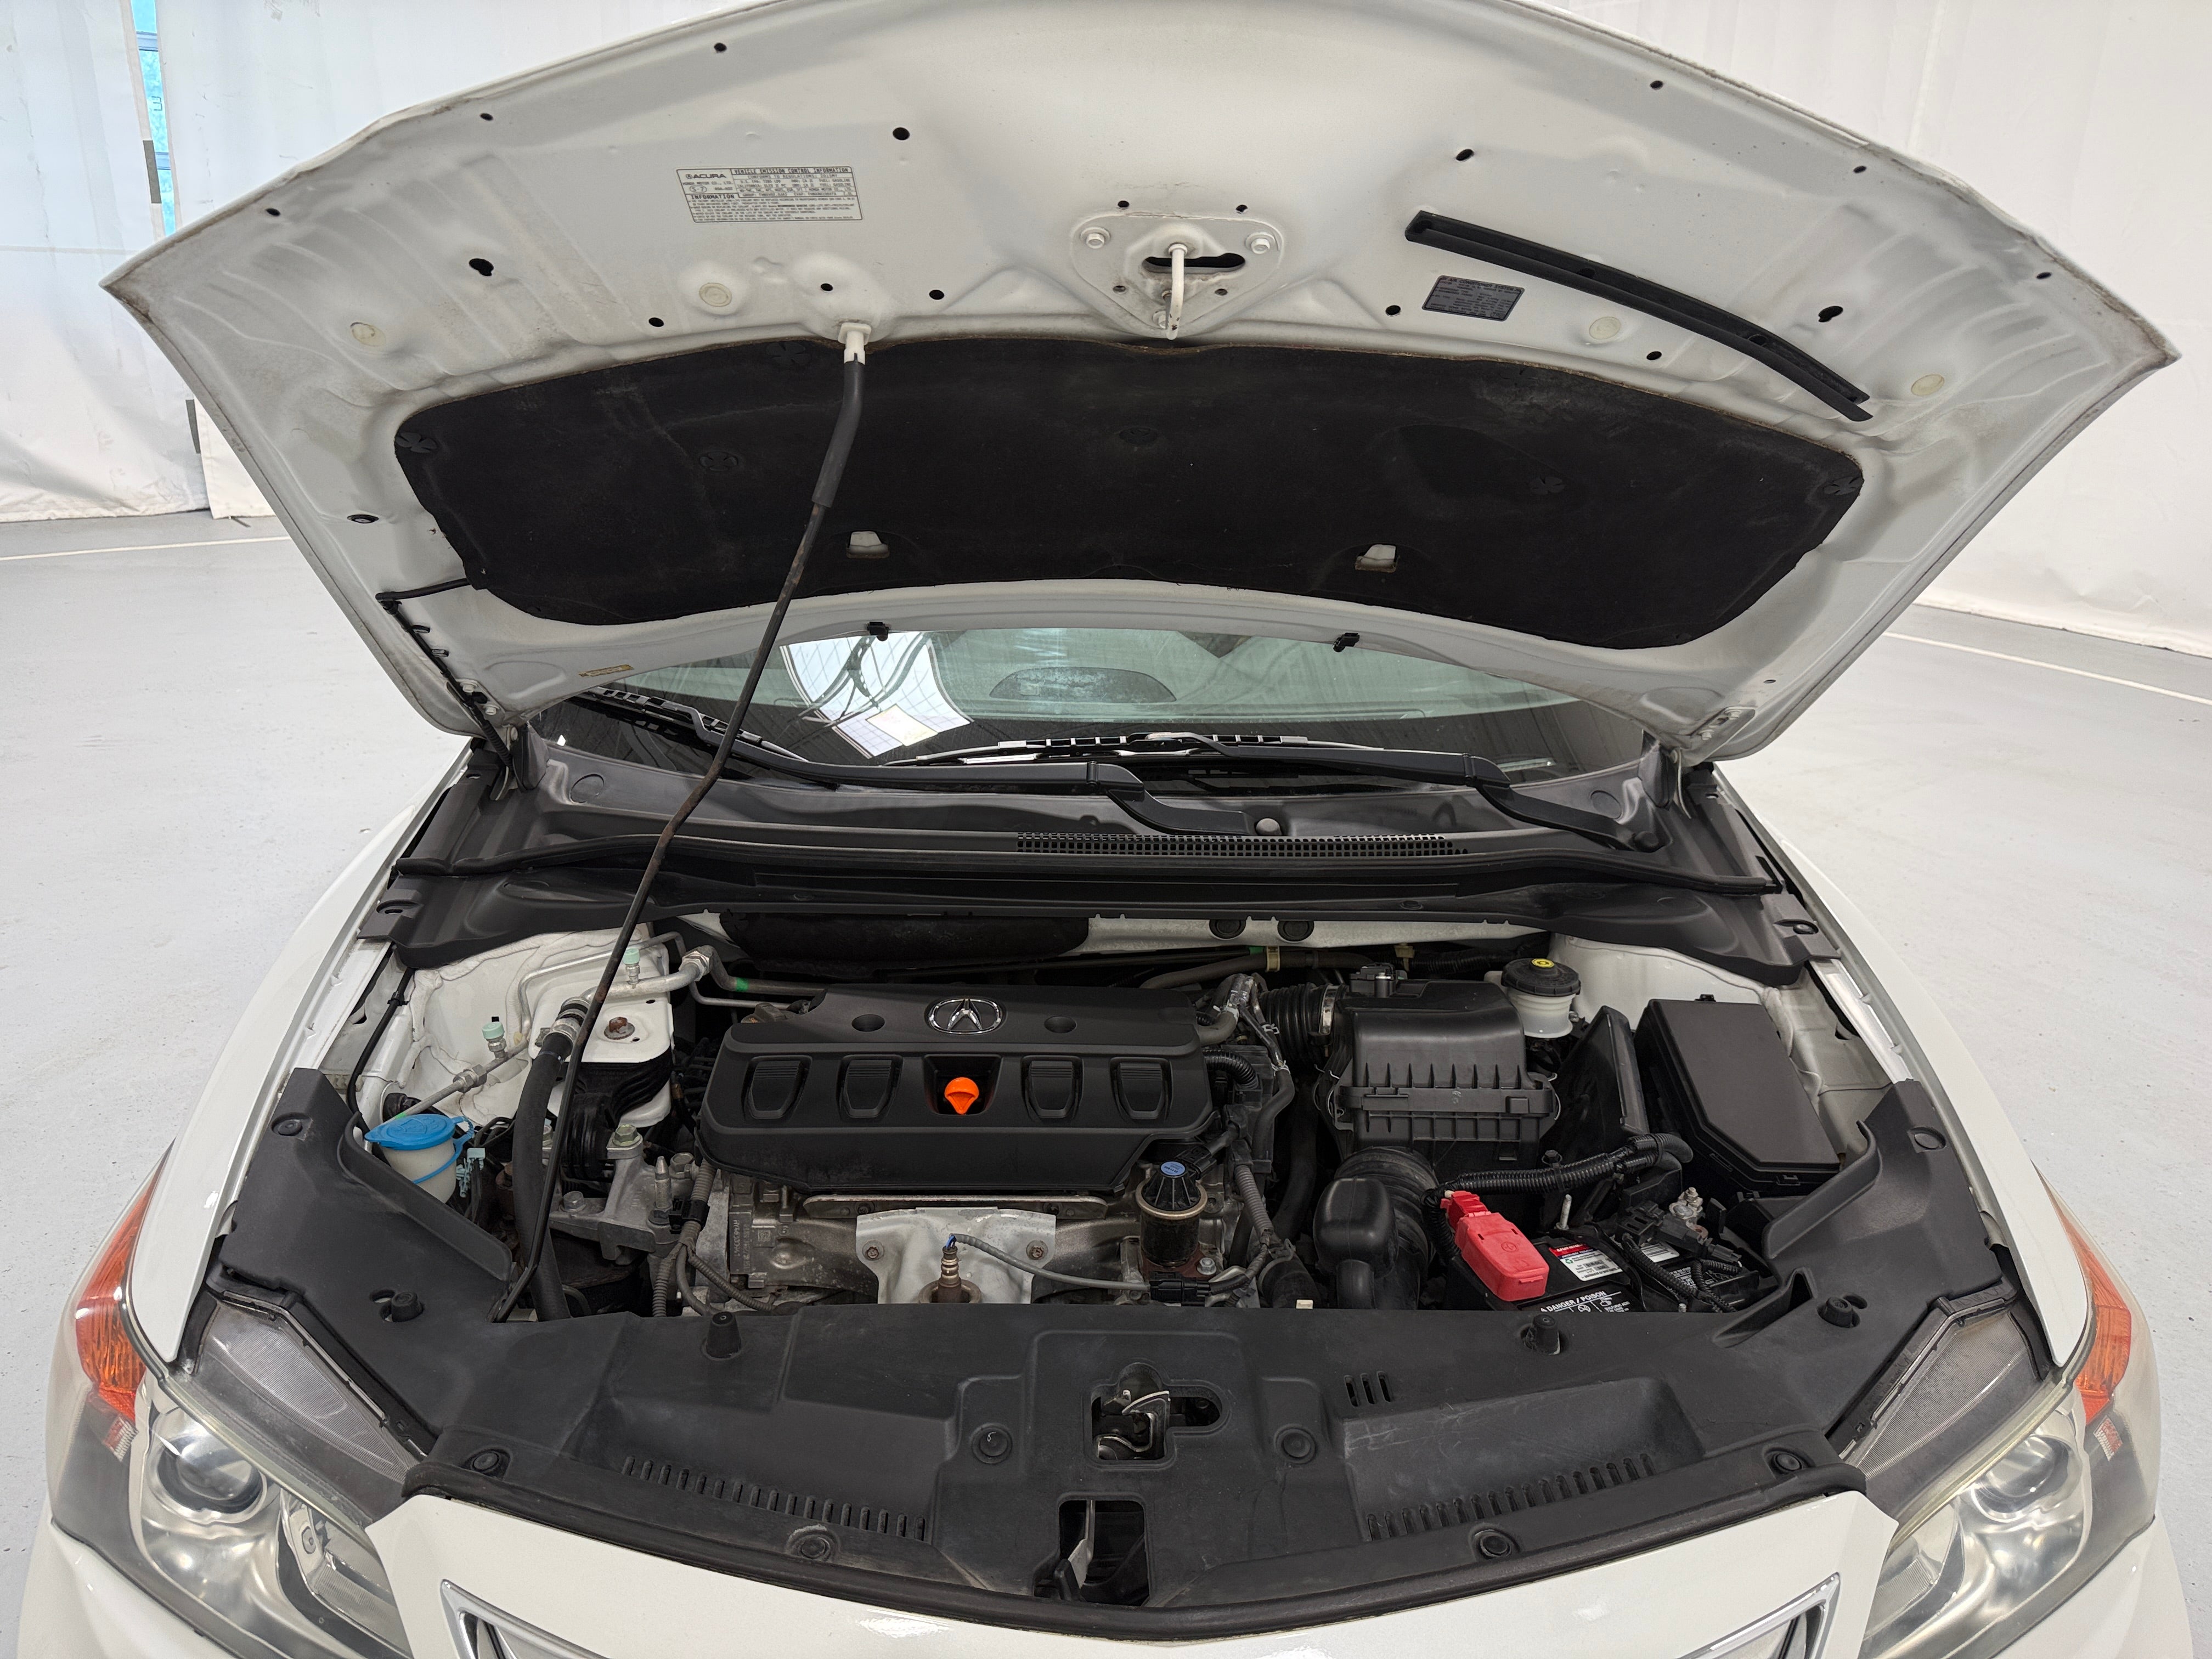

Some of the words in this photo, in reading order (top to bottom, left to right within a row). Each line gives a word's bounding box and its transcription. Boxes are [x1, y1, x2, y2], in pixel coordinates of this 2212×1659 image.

[1459, 279, 1492, 287] CONDITIONER
[1546, 1300, 1576, 1312] DANGER
[1580, 1291, 1607, 1302] POISON
